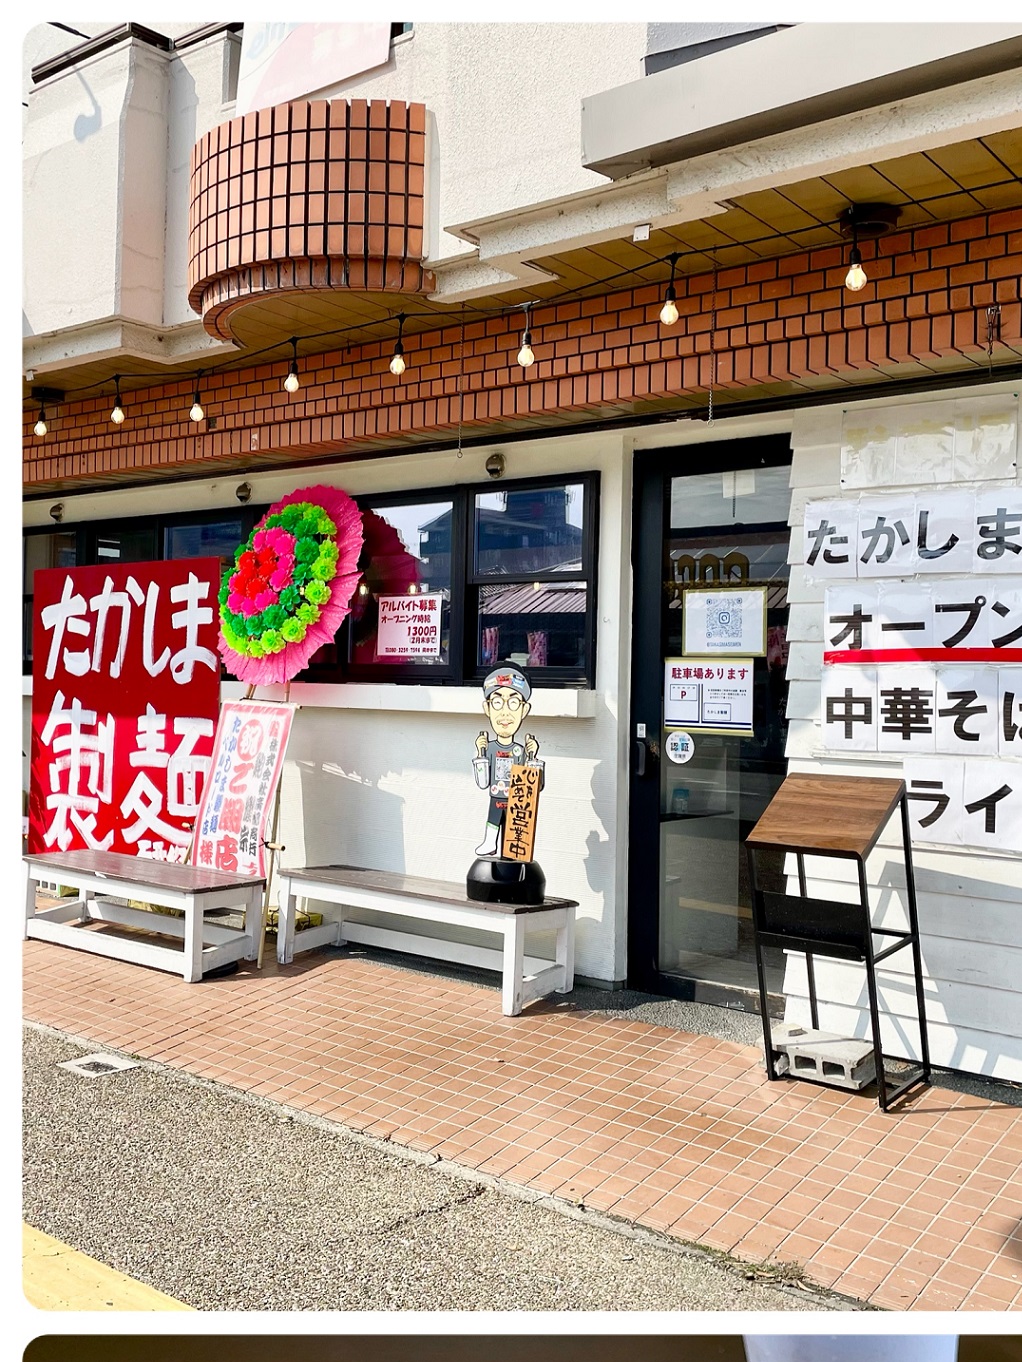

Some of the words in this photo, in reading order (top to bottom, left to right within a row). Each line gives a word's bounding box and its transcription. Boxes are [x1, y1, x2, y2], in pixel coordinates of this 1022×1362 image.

[381, 600, 437, 611] アルバイト募集
[40, 572, 217, 685] たかしま
[408, 626, 436, 636] 1300円
[672, 668, 748, 679] 駐車場あります
[681, 691, 686, 699] P
[40, 690, 213, 852] 製麺
[506, 802, 532, 858] 営業中
